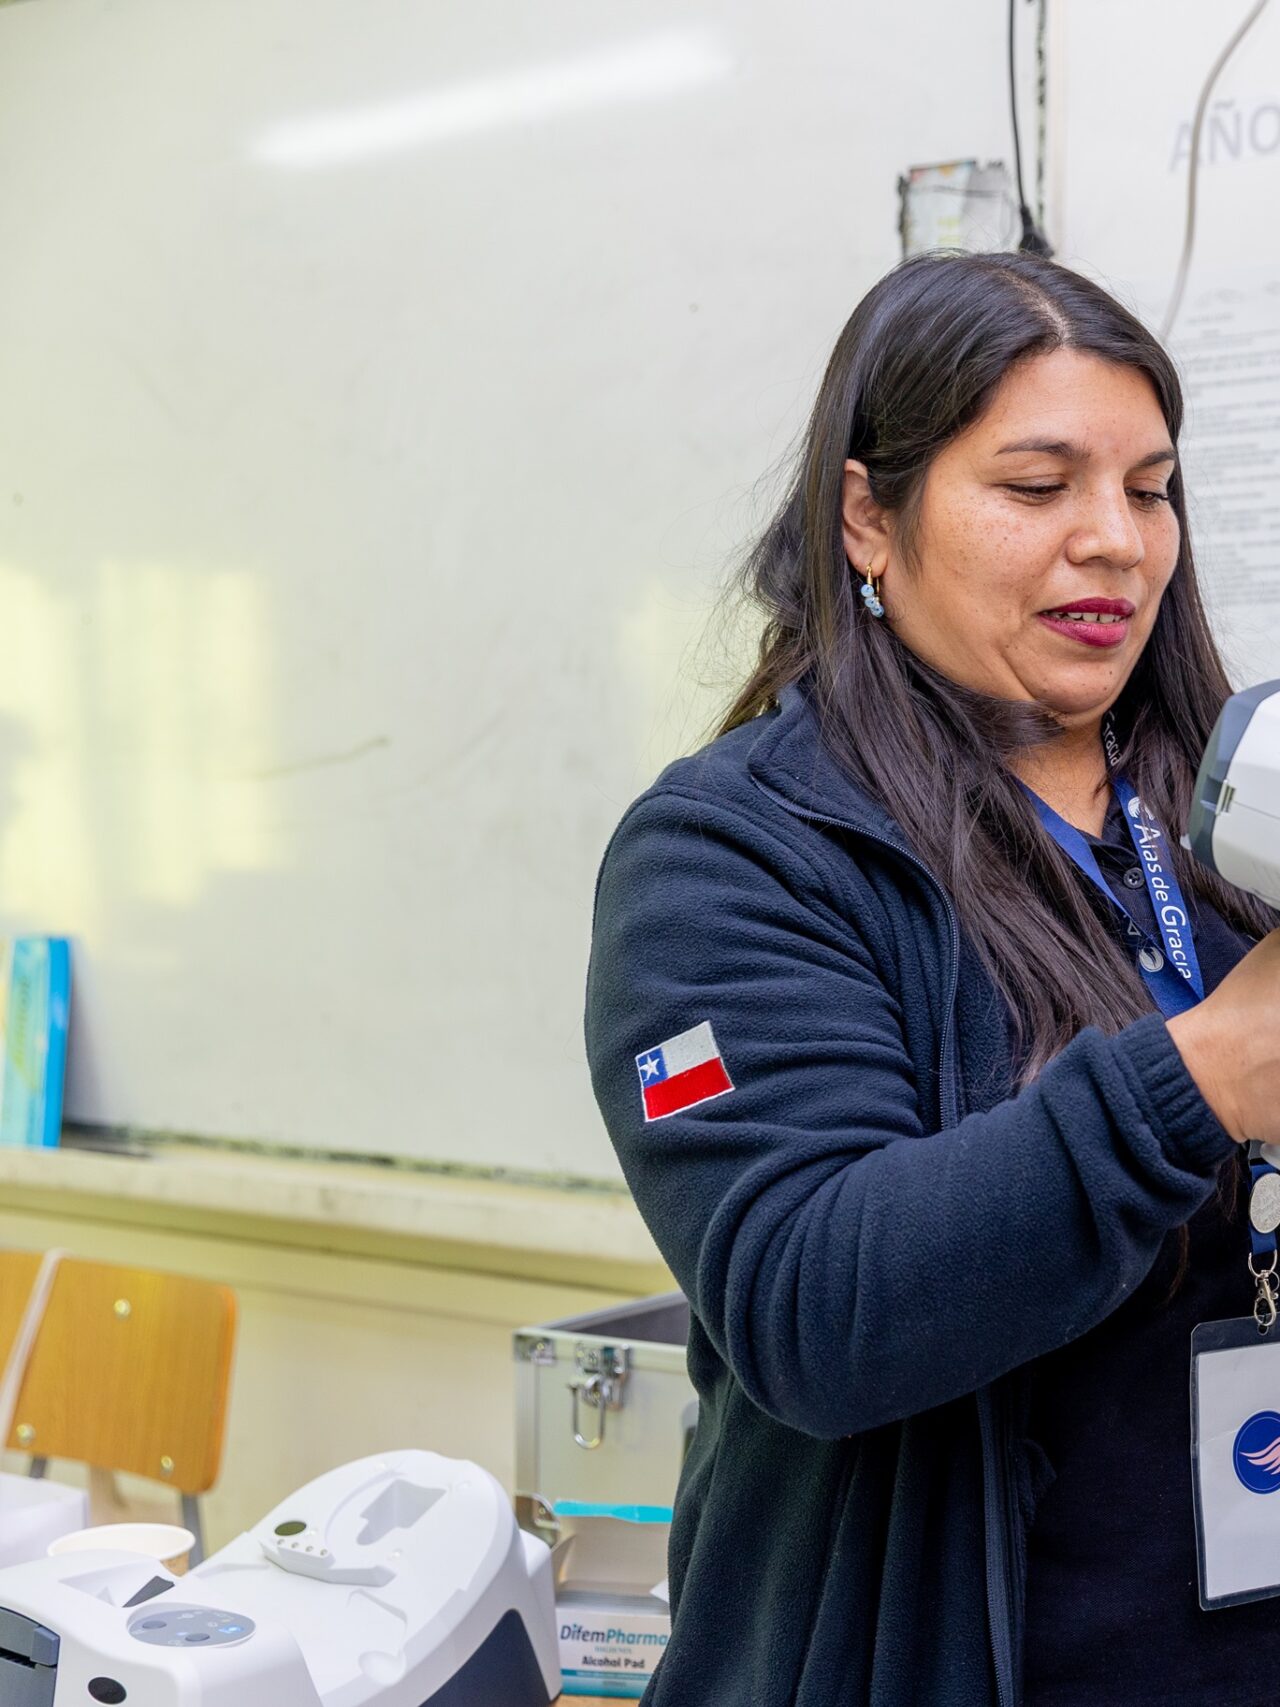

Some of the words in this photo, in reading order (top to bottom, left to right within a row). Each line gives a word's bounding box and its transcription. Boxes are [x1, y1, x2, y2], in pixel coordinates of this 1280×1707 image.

[1134, 824, 1162, 873] Alas
[1151, 877, 1170, 901] de
[1161, 905, 1192, 979] Gracia
[560, 1623, 668, 1646] DifemPharma
[582, 1655, 621, 1668] Alcohol
[624, 1657, 645, 1669] Pad
